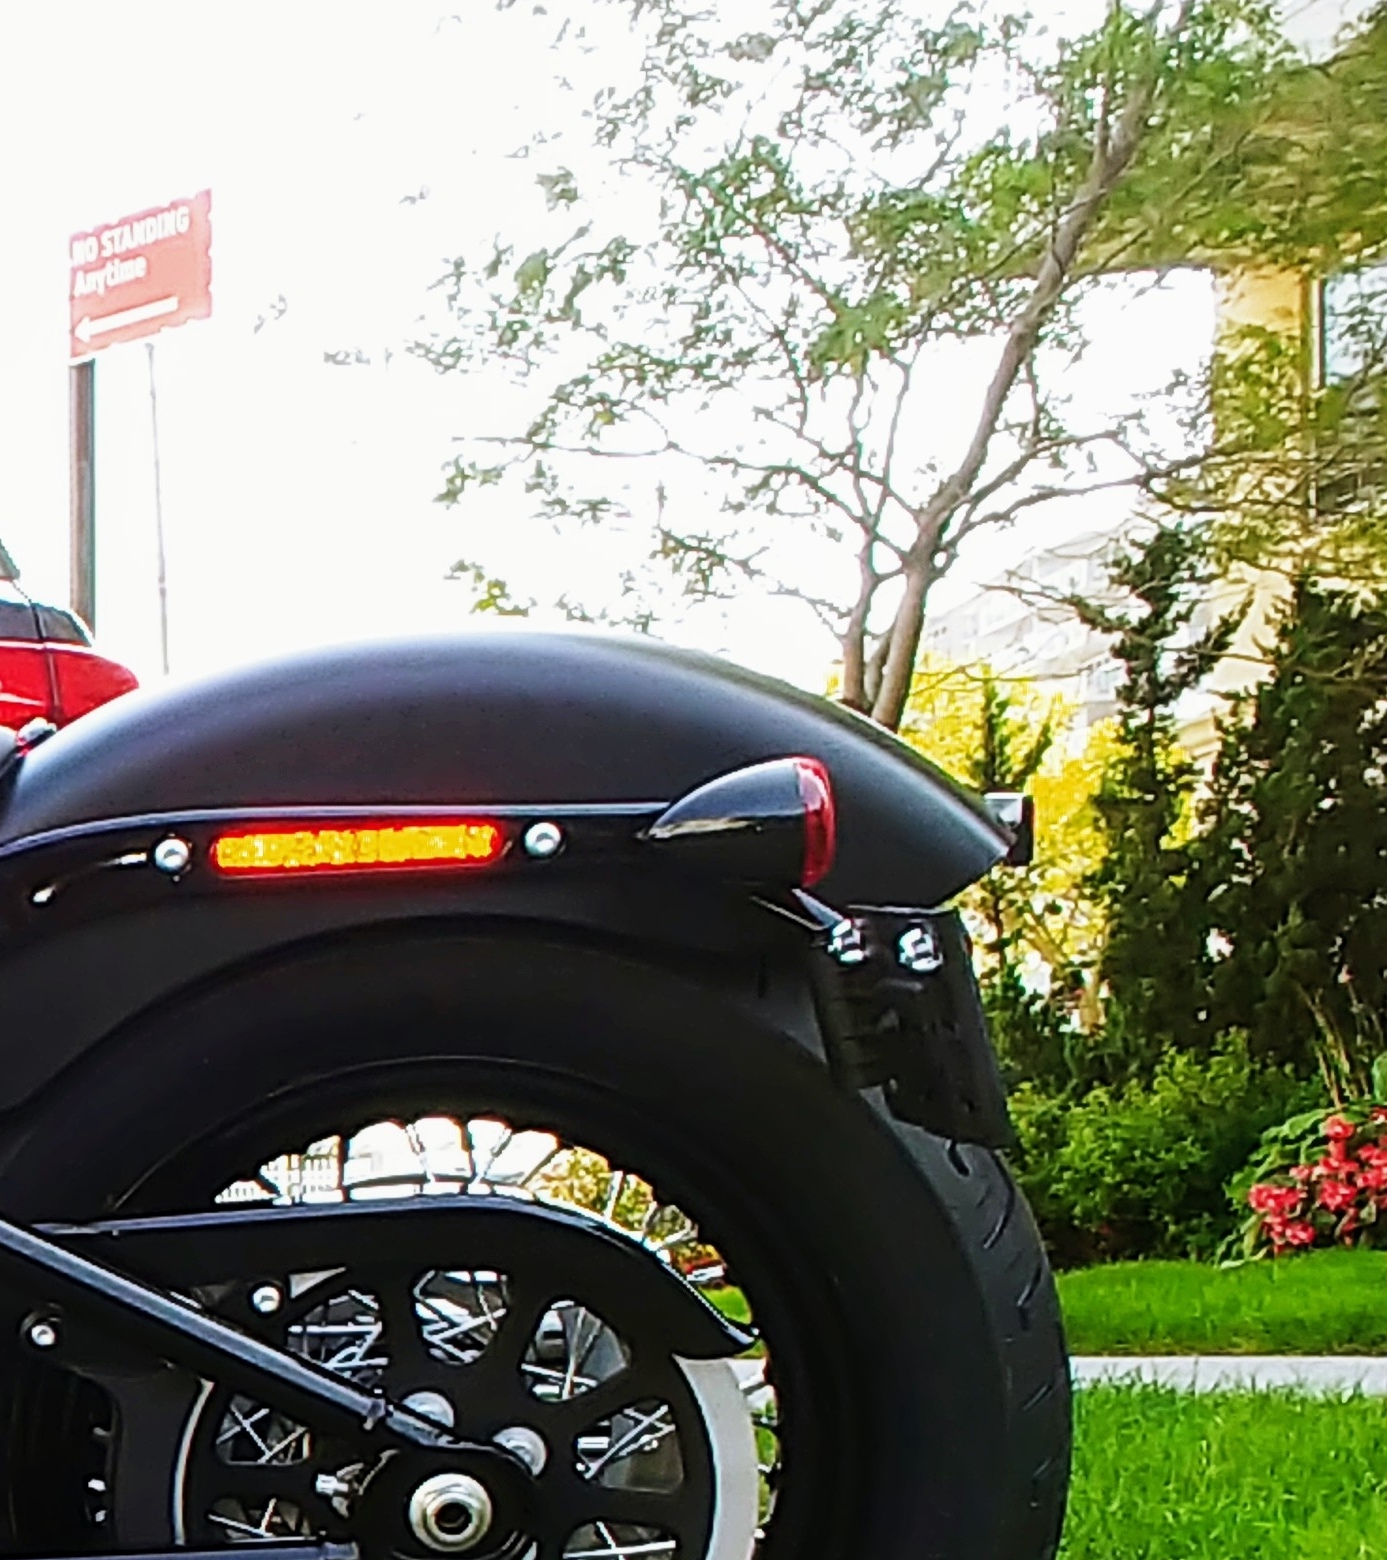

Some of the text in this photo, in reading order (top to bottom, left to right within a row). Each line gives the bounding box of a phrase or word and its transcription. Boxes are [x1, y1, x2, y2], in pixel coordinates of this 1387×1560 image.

[72, 206, 190, 266] NO STANDING
[74, 257, 147, 297] Anytime
